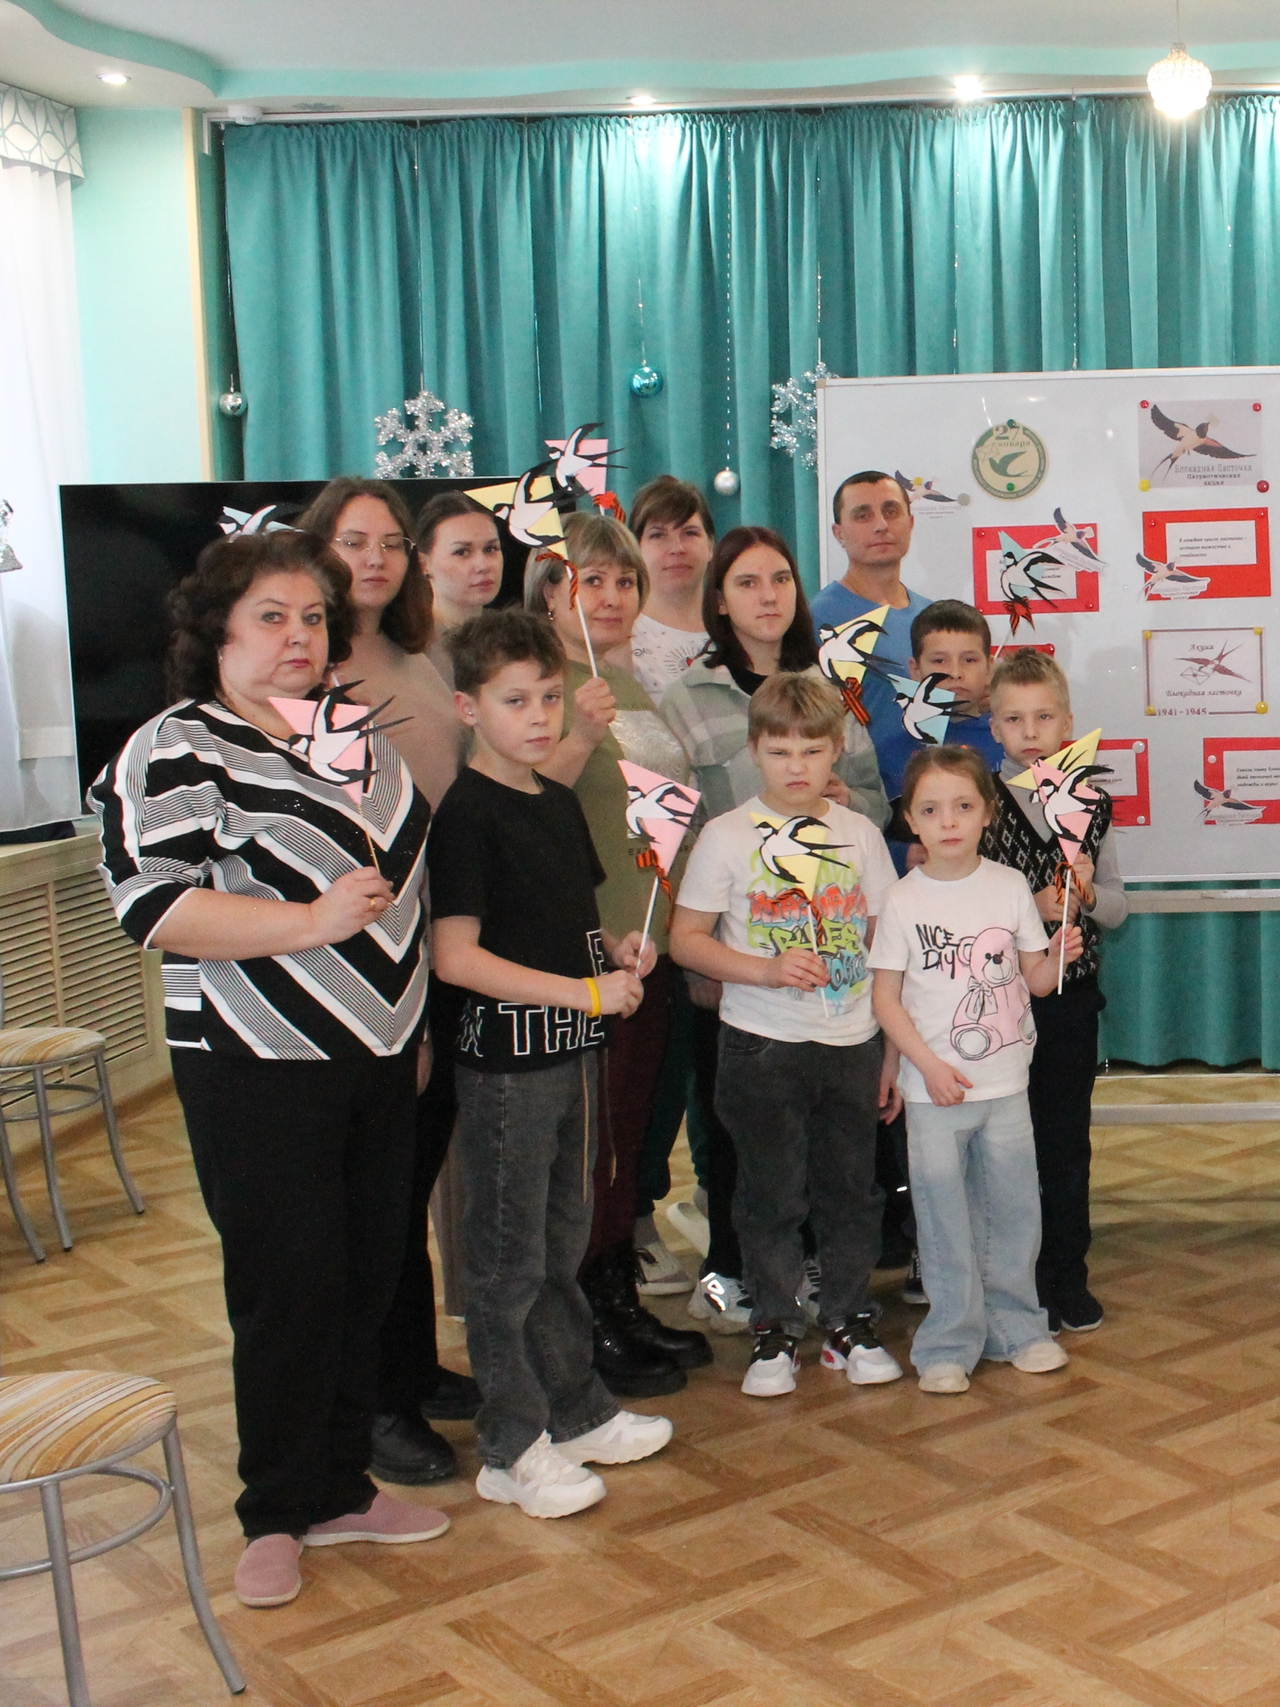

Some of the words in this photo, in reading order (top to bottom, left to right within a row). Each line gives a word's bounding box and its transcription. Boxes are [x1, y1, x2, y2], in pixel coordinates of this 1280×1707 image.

[995, 425, 1020, 441] 27
[1189, 644, 1214, 653] Акция
[1166, 689, 1206, 698] Блокадная
[1158, 708, 1177, 716] 1941
[1186, 708, 1207, 716] 1945
[915, 923, 960, 951] NICE
[922, 948, 957, 979] DAY
[498, 1003, 605, 1056] THE
